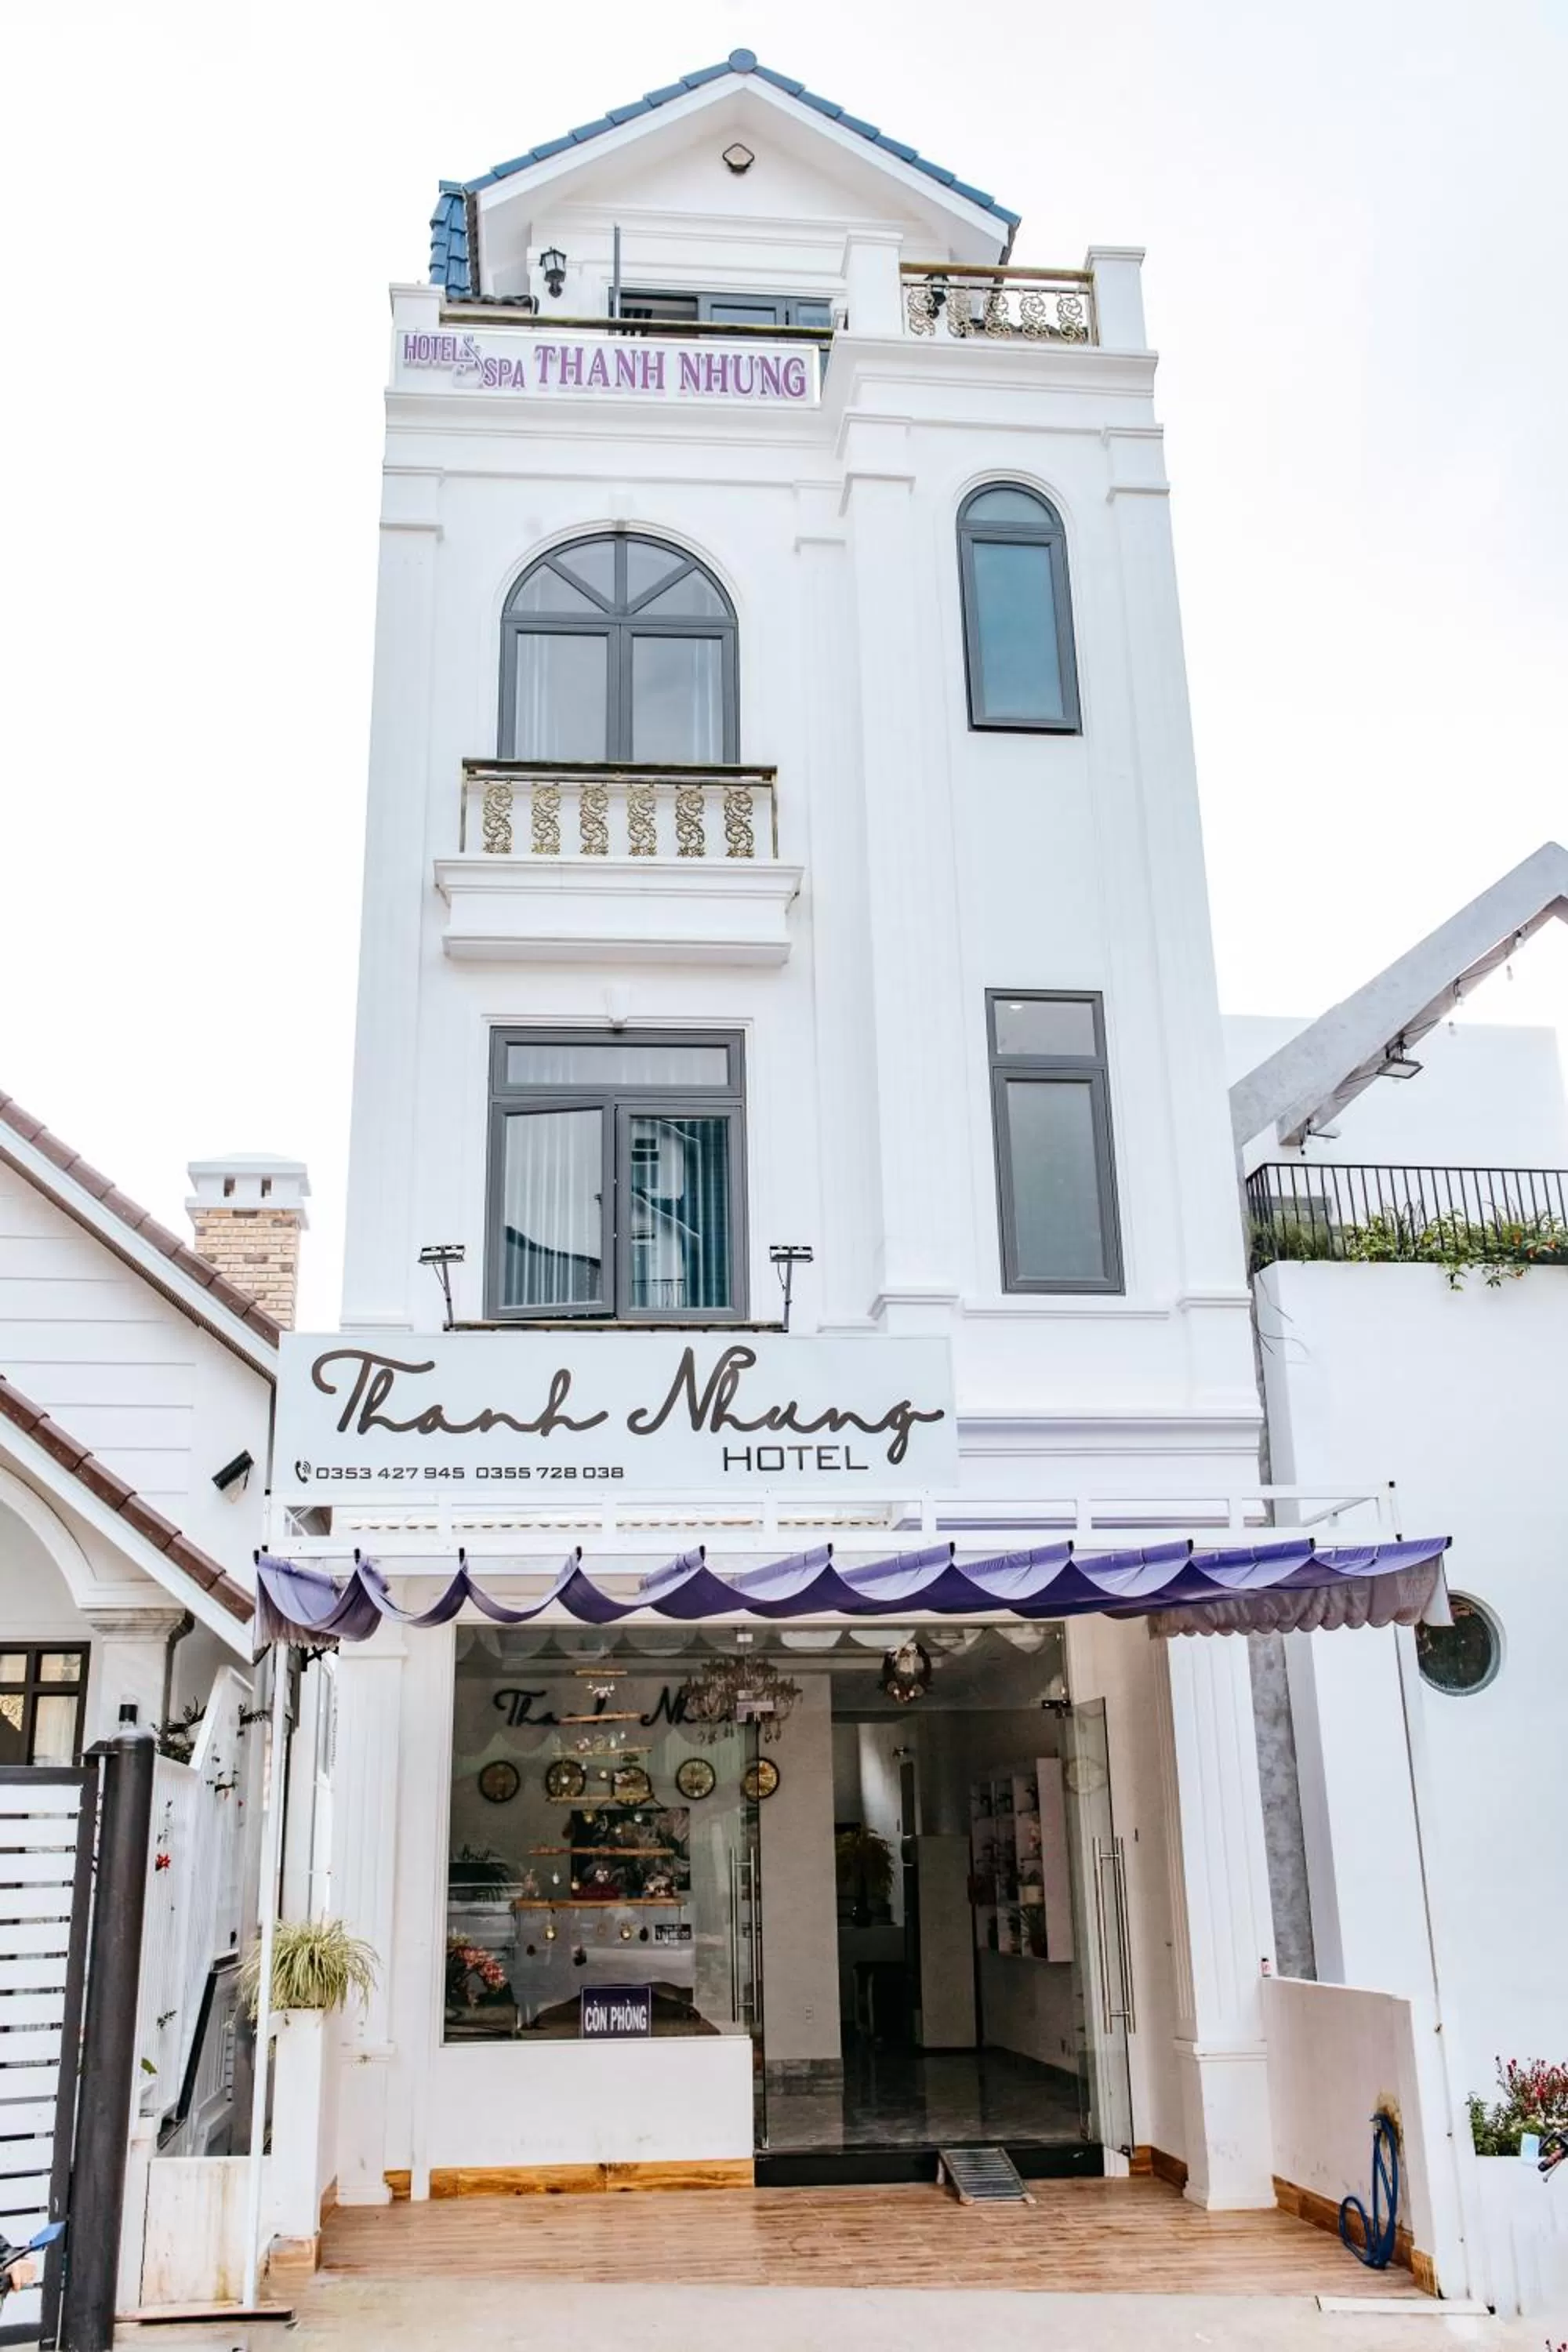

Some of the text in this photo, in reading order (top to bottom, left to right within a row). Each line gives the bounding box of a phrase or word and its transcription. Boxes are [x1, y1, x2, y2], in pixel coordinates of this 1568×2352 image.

[404, 335, 474, 363] HOTEL
[482, 358, 525, 388] SPA
[535, 345, 806, 397] THANH NHUNG
[312, 1345, 945, 1465] Thanh Nhung
[316, 1467, 624, 1479] 0353 427 945 0355 728 038
[723, 1446, 869, 1471] HOTEL
[584, 1998, 647, 2032] CÒN PHÒNG
